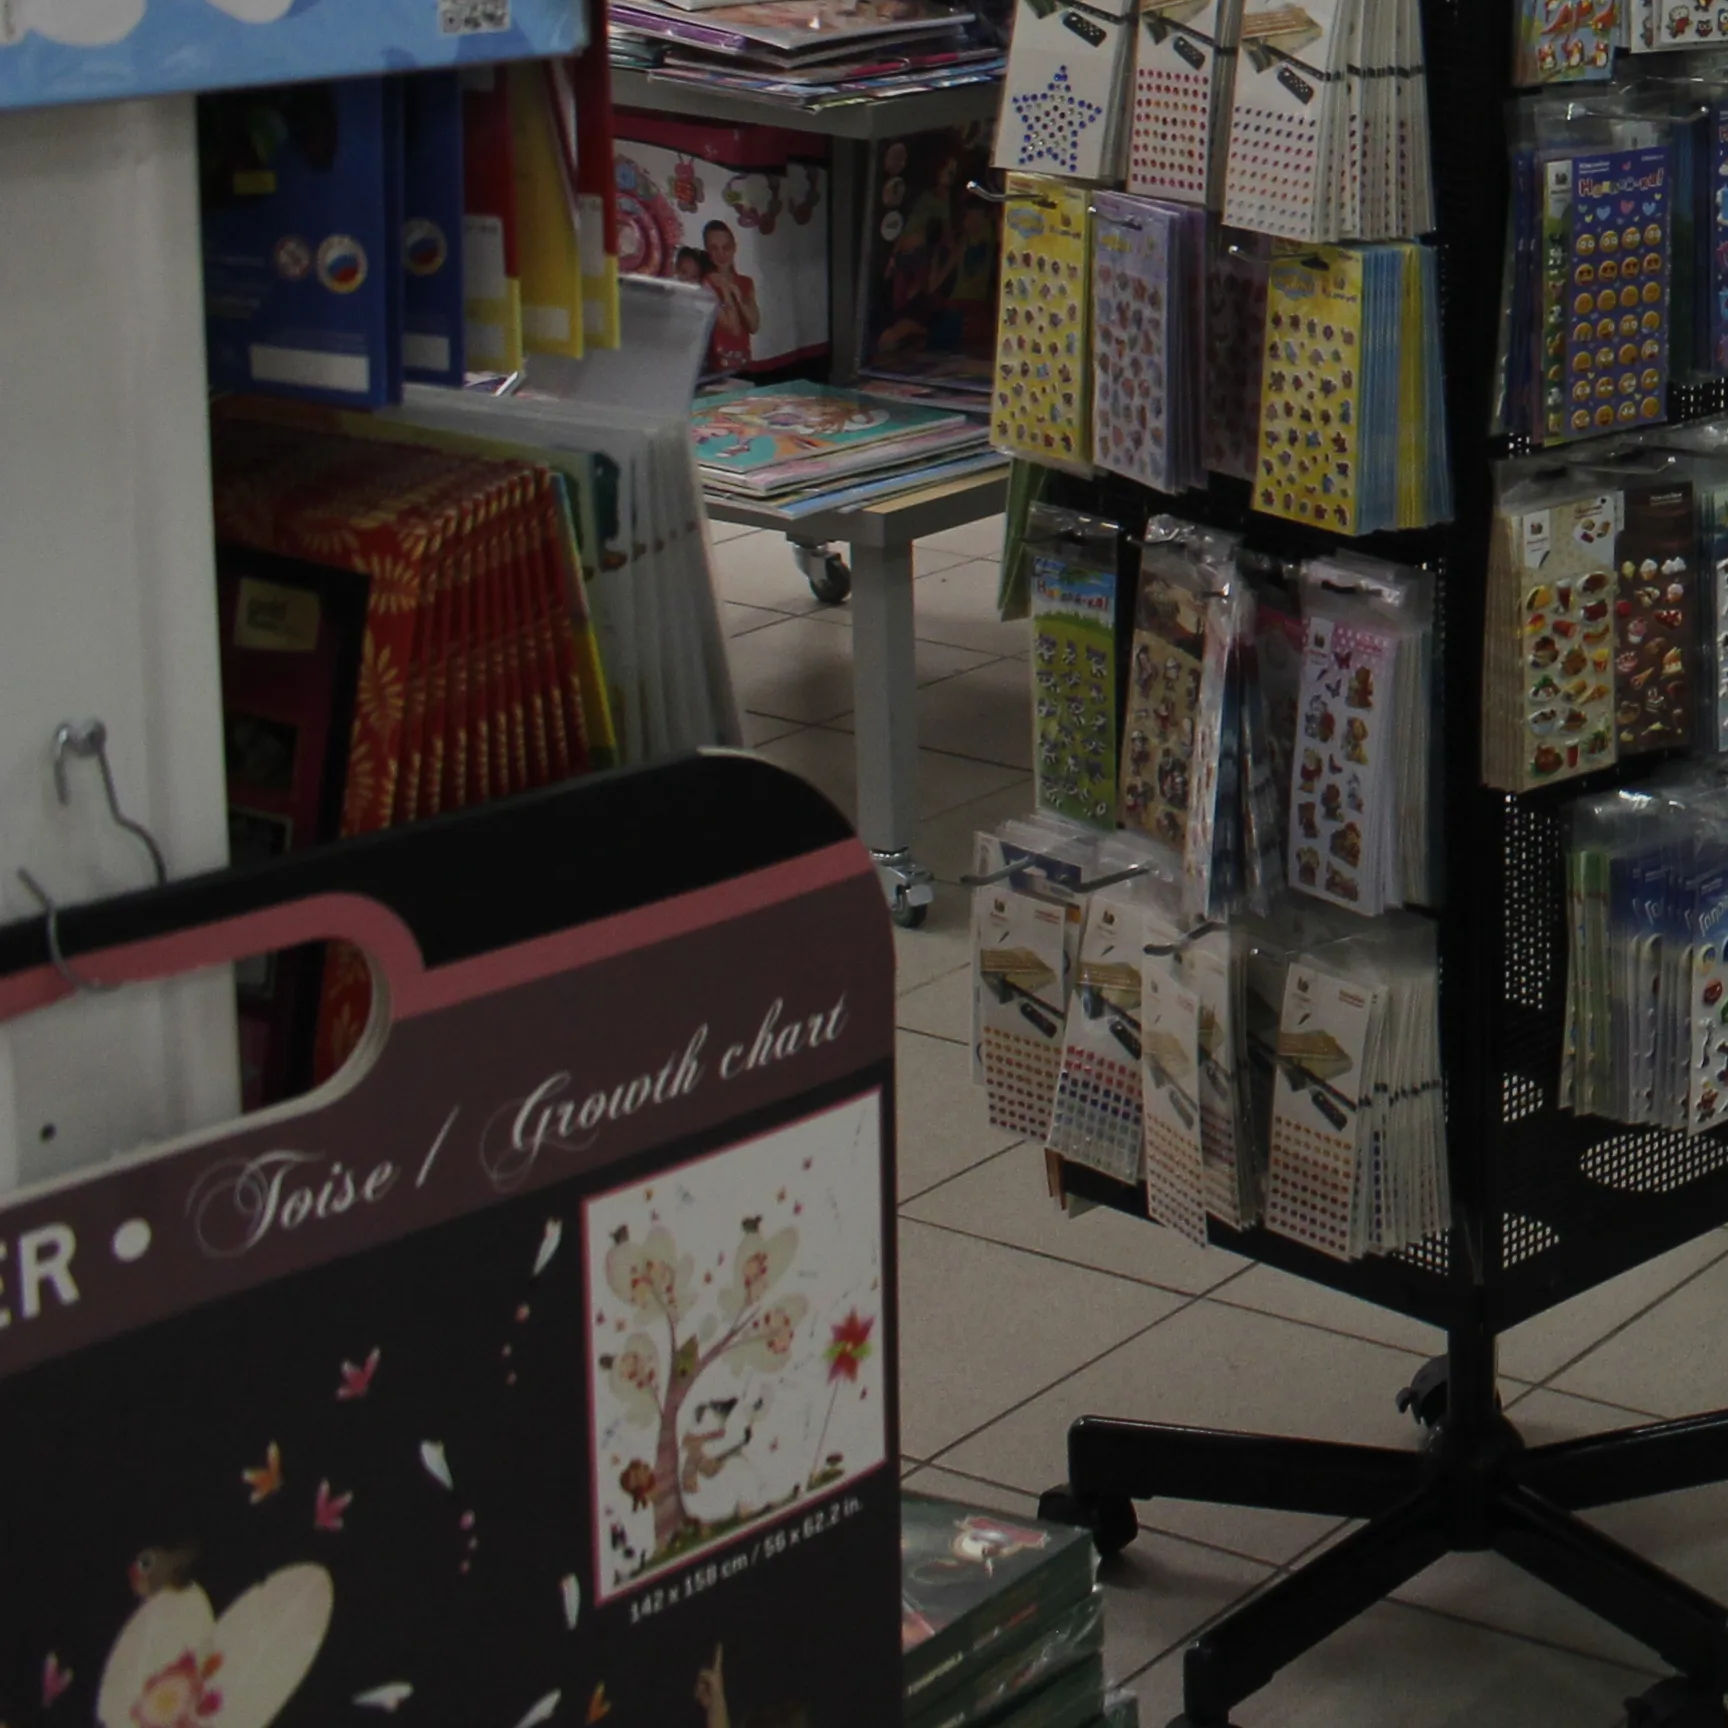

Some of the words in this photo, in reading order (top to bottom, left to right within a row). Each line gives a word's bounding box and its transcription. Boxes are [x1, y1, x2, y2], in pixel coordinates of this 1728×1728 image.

[186, 1148, 401, 1258] Toise
[477, 1024, 706, 1193] Growth
[718, 991, 853, 1081] chart
